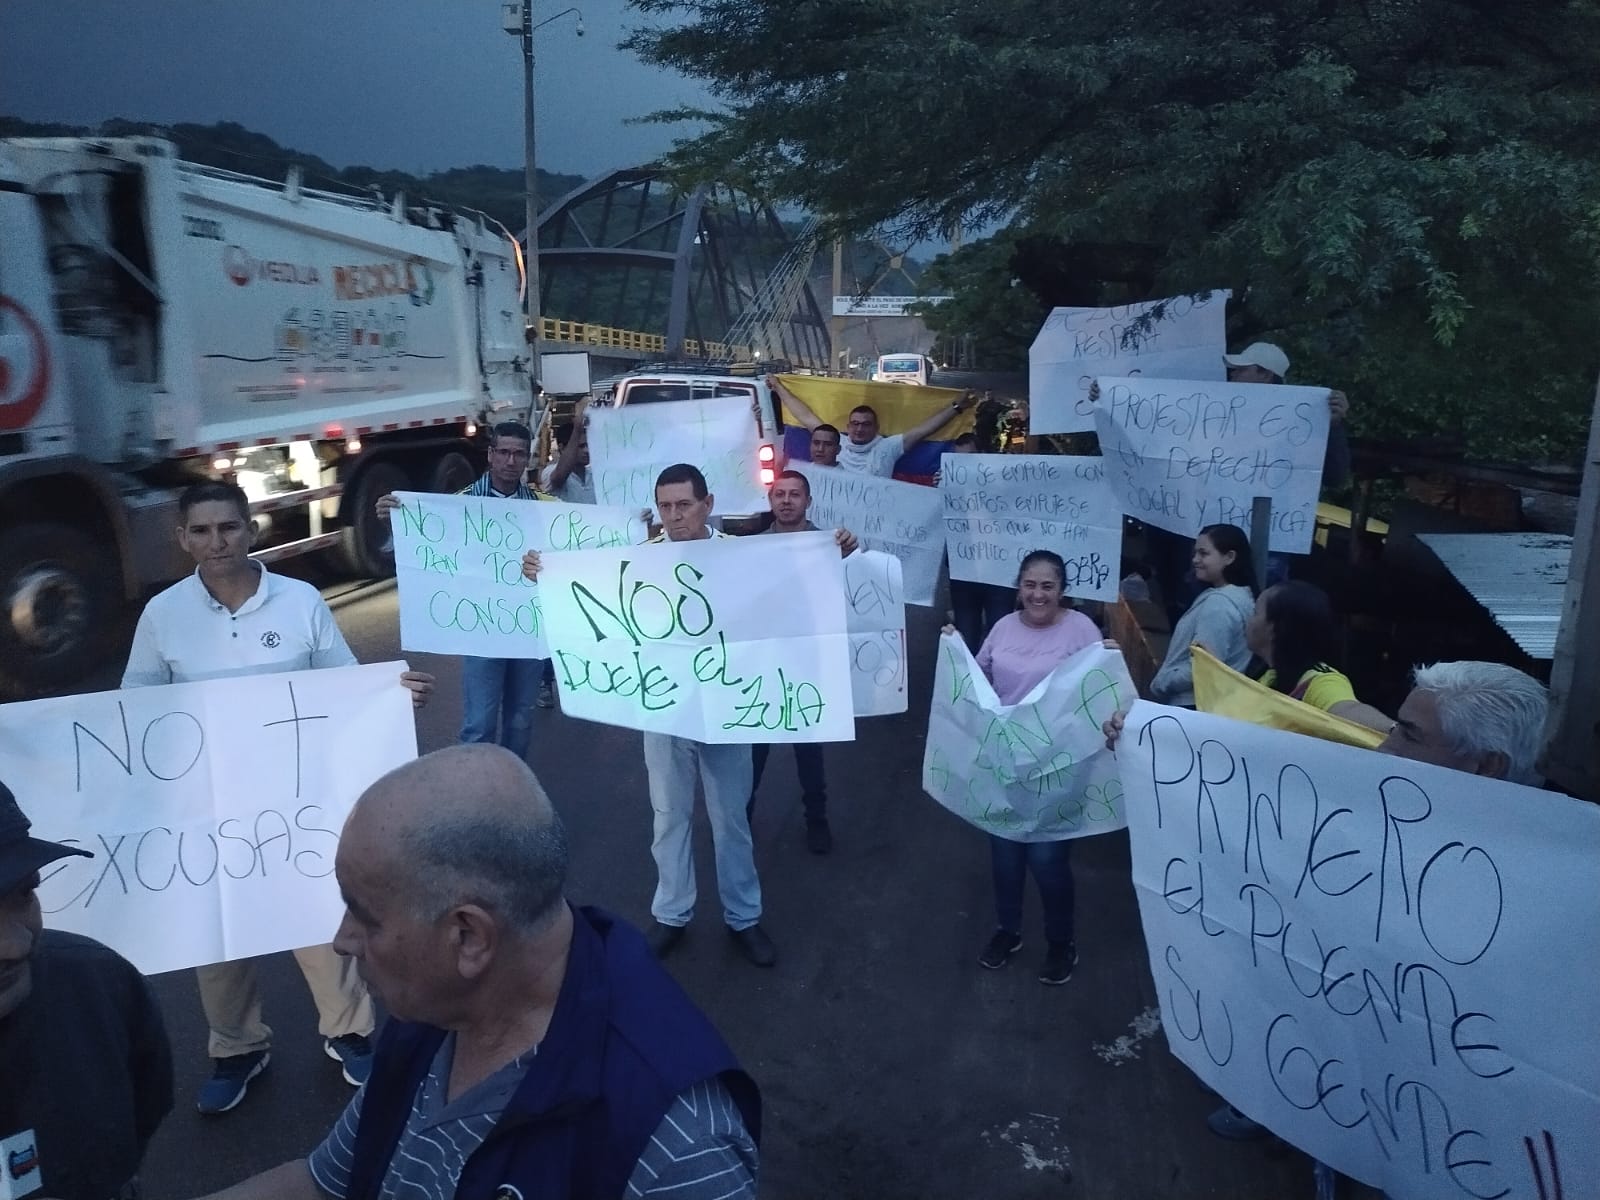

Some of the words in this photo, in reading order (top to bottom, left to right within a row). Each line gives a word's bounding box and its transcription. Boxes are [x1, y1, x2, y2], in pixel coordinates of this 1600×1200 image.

[1109, 384, 1246, 442] PROTESTAR
[1259, 402, 1313, 447] ES
[944, 460, 968, 487] NO
[976, 462, 994, 487] SE
[1166, 446, 1294, 490] DERECHO
[401, 499, 445, 543] NO
[464, 503, 524, 551] NOS
[570, 560, 714, 646] NOS
[556, 649, 679, 710] DUELE
[693, 631, 742, 686] EL
[73, 701, 203, 792] NO
[1138, 714, 1503, 966] PRIMERO
[1164, 857, 1225, 937] EL
[1239, 883, 1515, 1078] PUENTE
[1166, 945, 1233, 1067] SU
